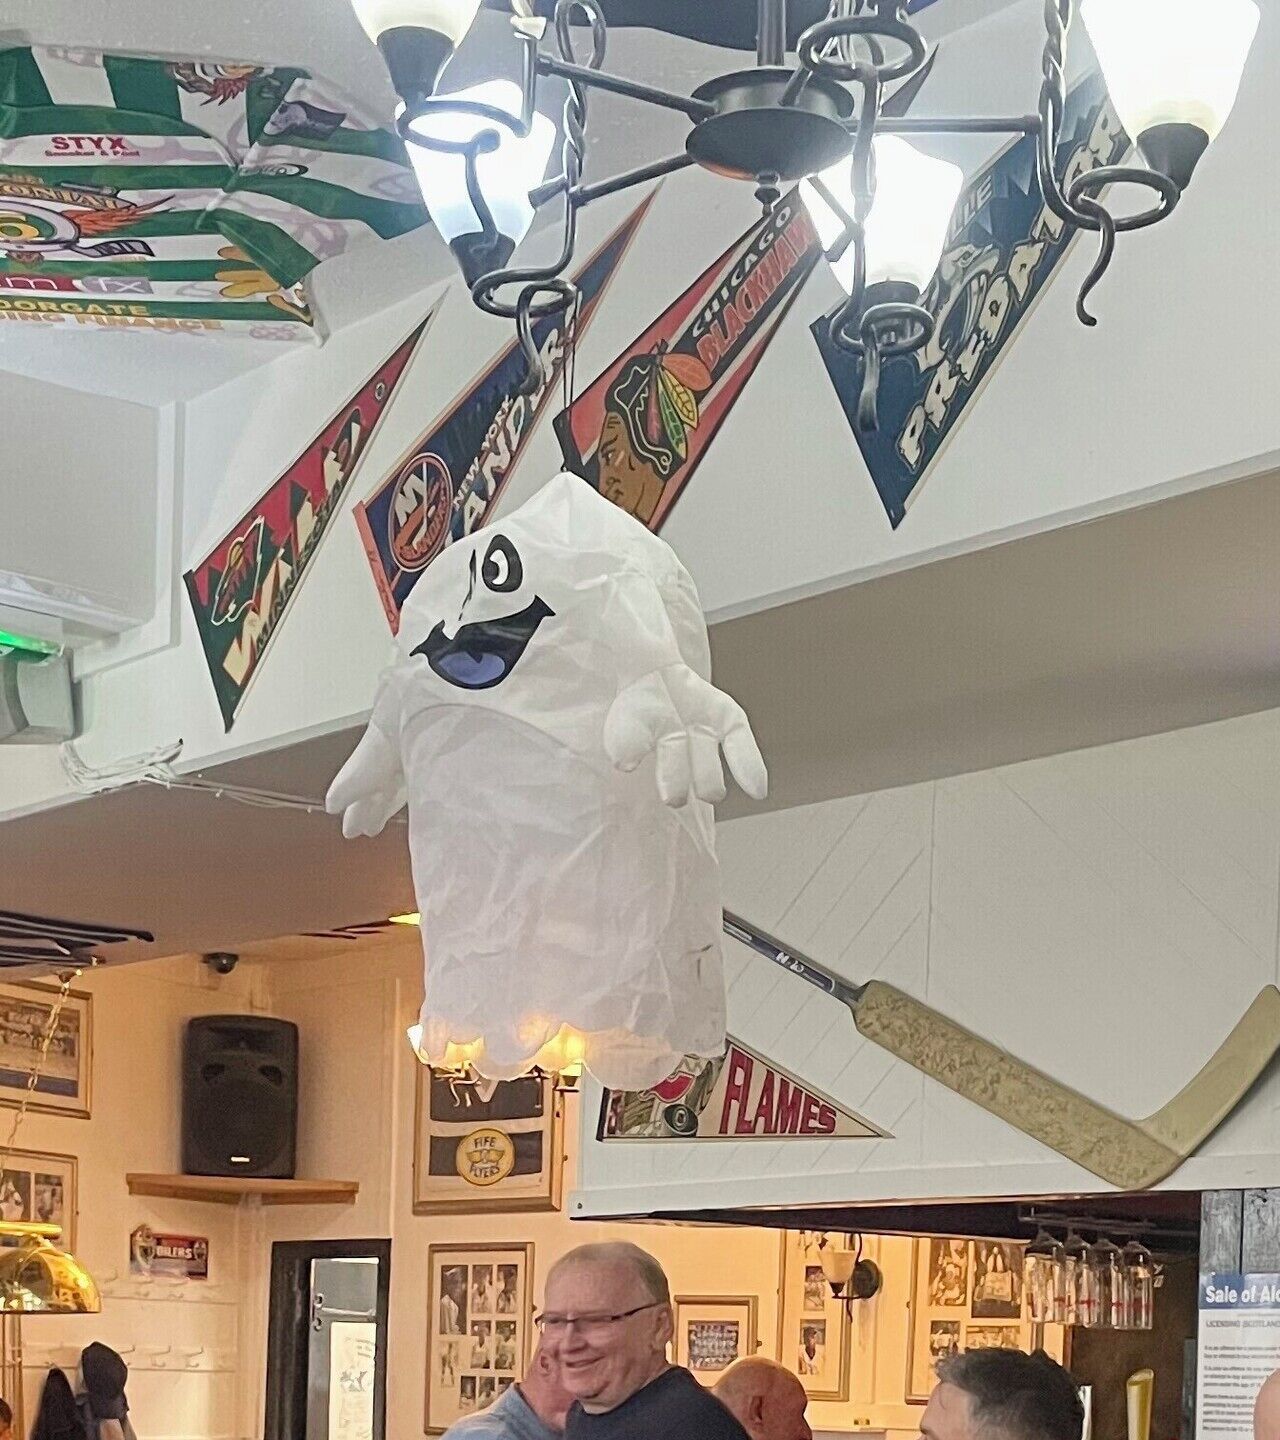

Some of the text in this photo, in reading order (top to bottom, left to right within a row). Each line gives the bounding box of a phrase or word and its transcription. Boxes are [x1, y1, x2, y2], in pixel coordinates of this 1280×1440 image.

[51, 136, 127, 150] STYX
[692, 206, 791, 337] CHICAGO
[896, 107, 1116, 473] PREDATOR
[453, 394, 513, 512] NEW YORK
[719, 1046, 837, 1134] FLAMES
[474, 1136, 497, 1149] FIFE
[469, 1163, 500, 1178] FLYERS
[156, 1245, 193, 1259] OILERS
[1206, 1285, 1237, 1303] Sale
[1241, 1286, 1256, 1303] of
